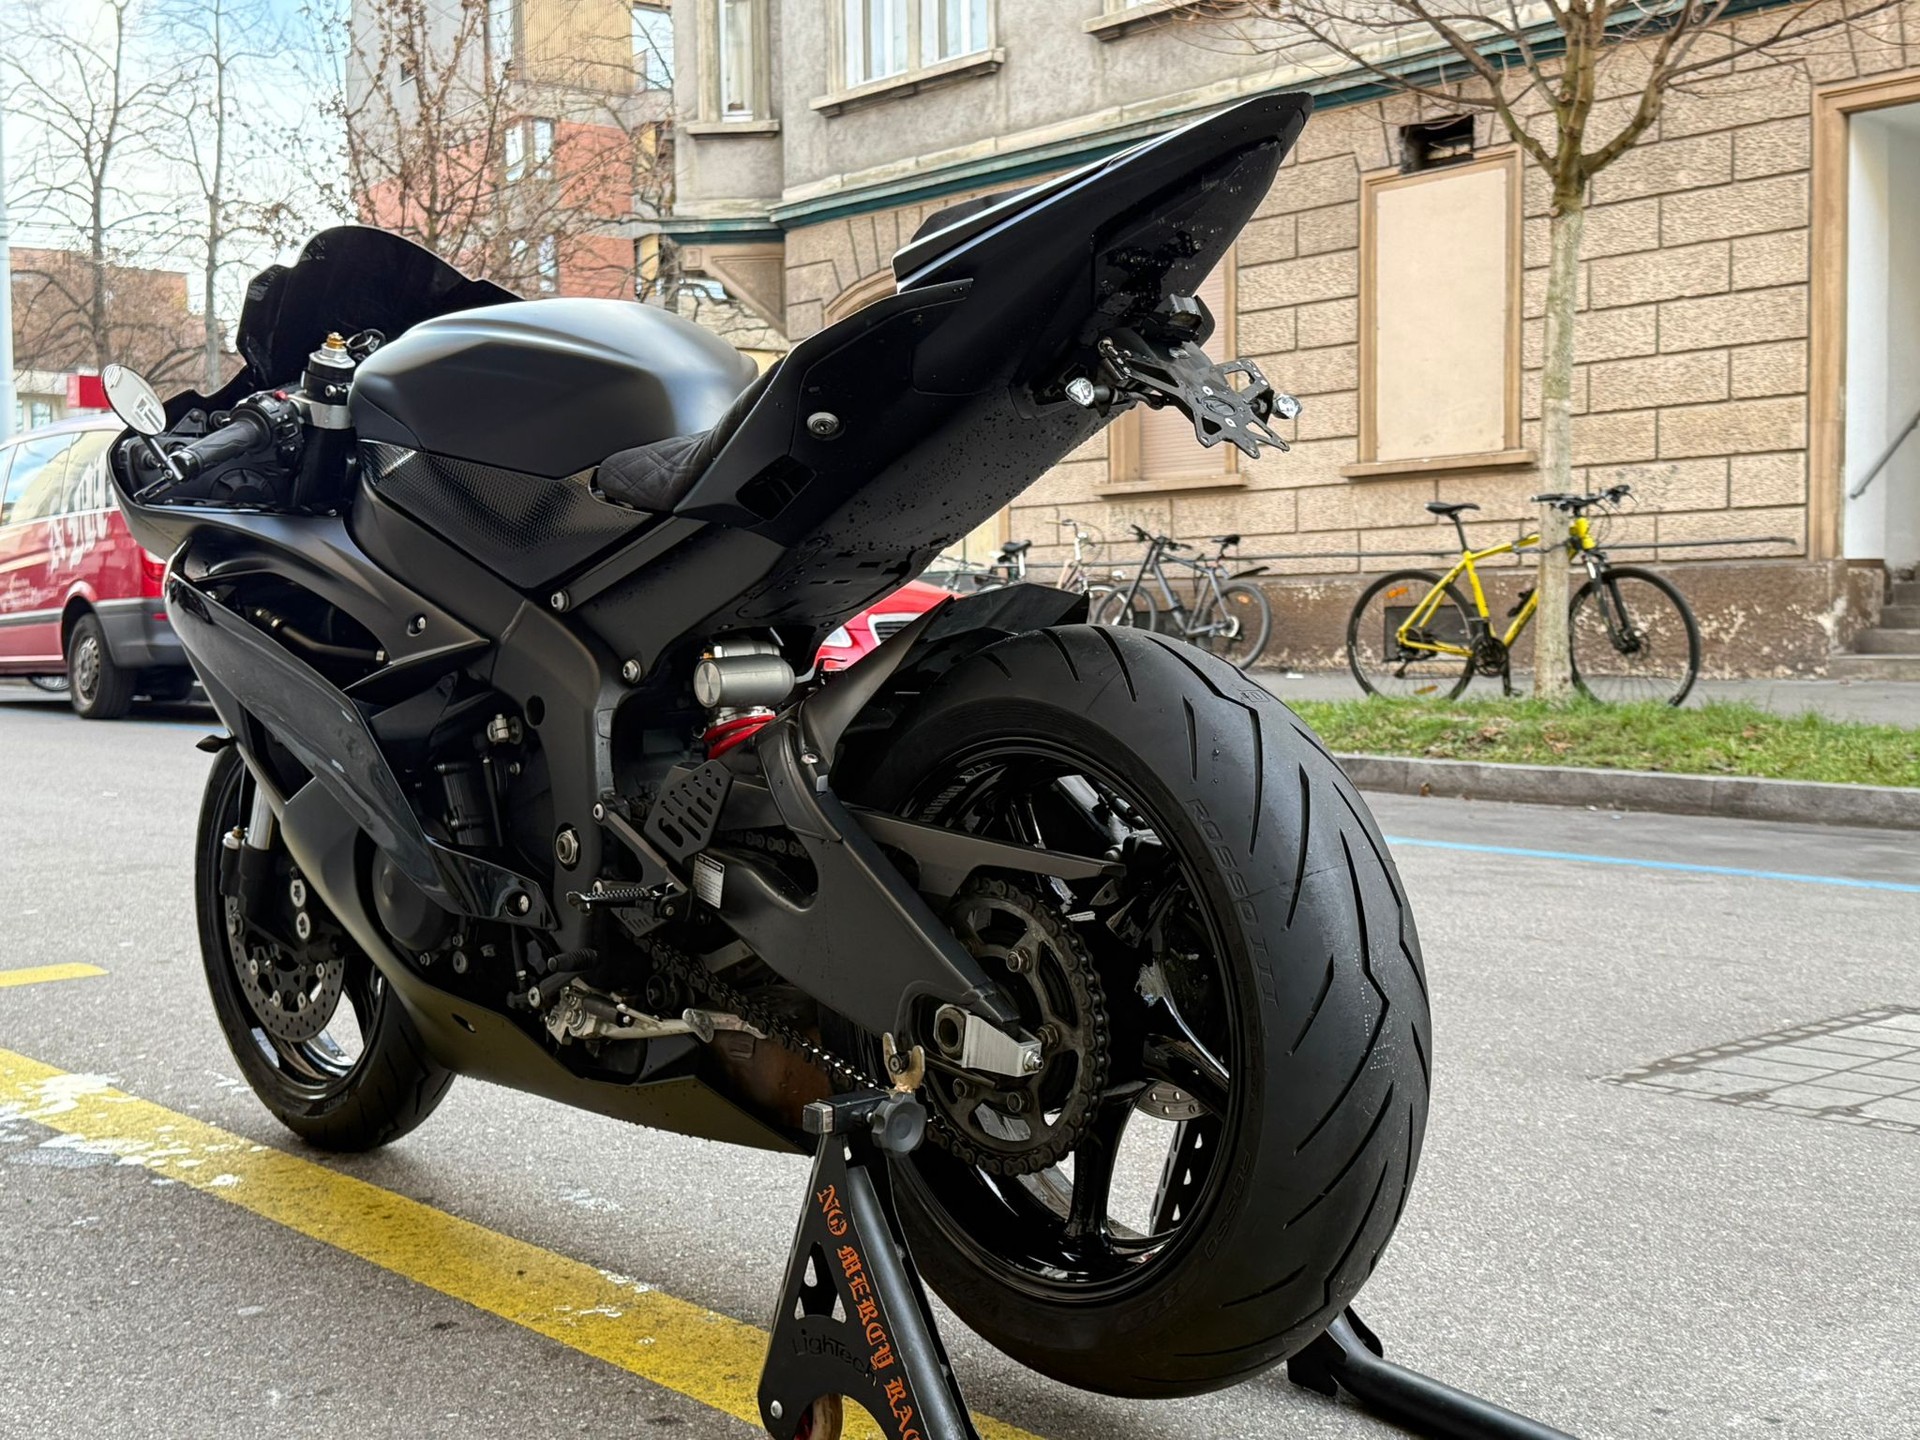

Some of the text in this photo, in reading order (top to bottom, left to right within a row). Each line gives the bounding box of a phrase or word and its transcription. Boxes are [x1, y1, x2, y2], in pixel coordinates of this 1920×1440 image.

[1187, 799, 1258, 924] ROSSO
[817, 1184, 849, 1237] NO
[837, 1245, 895, 1371] MERCY
